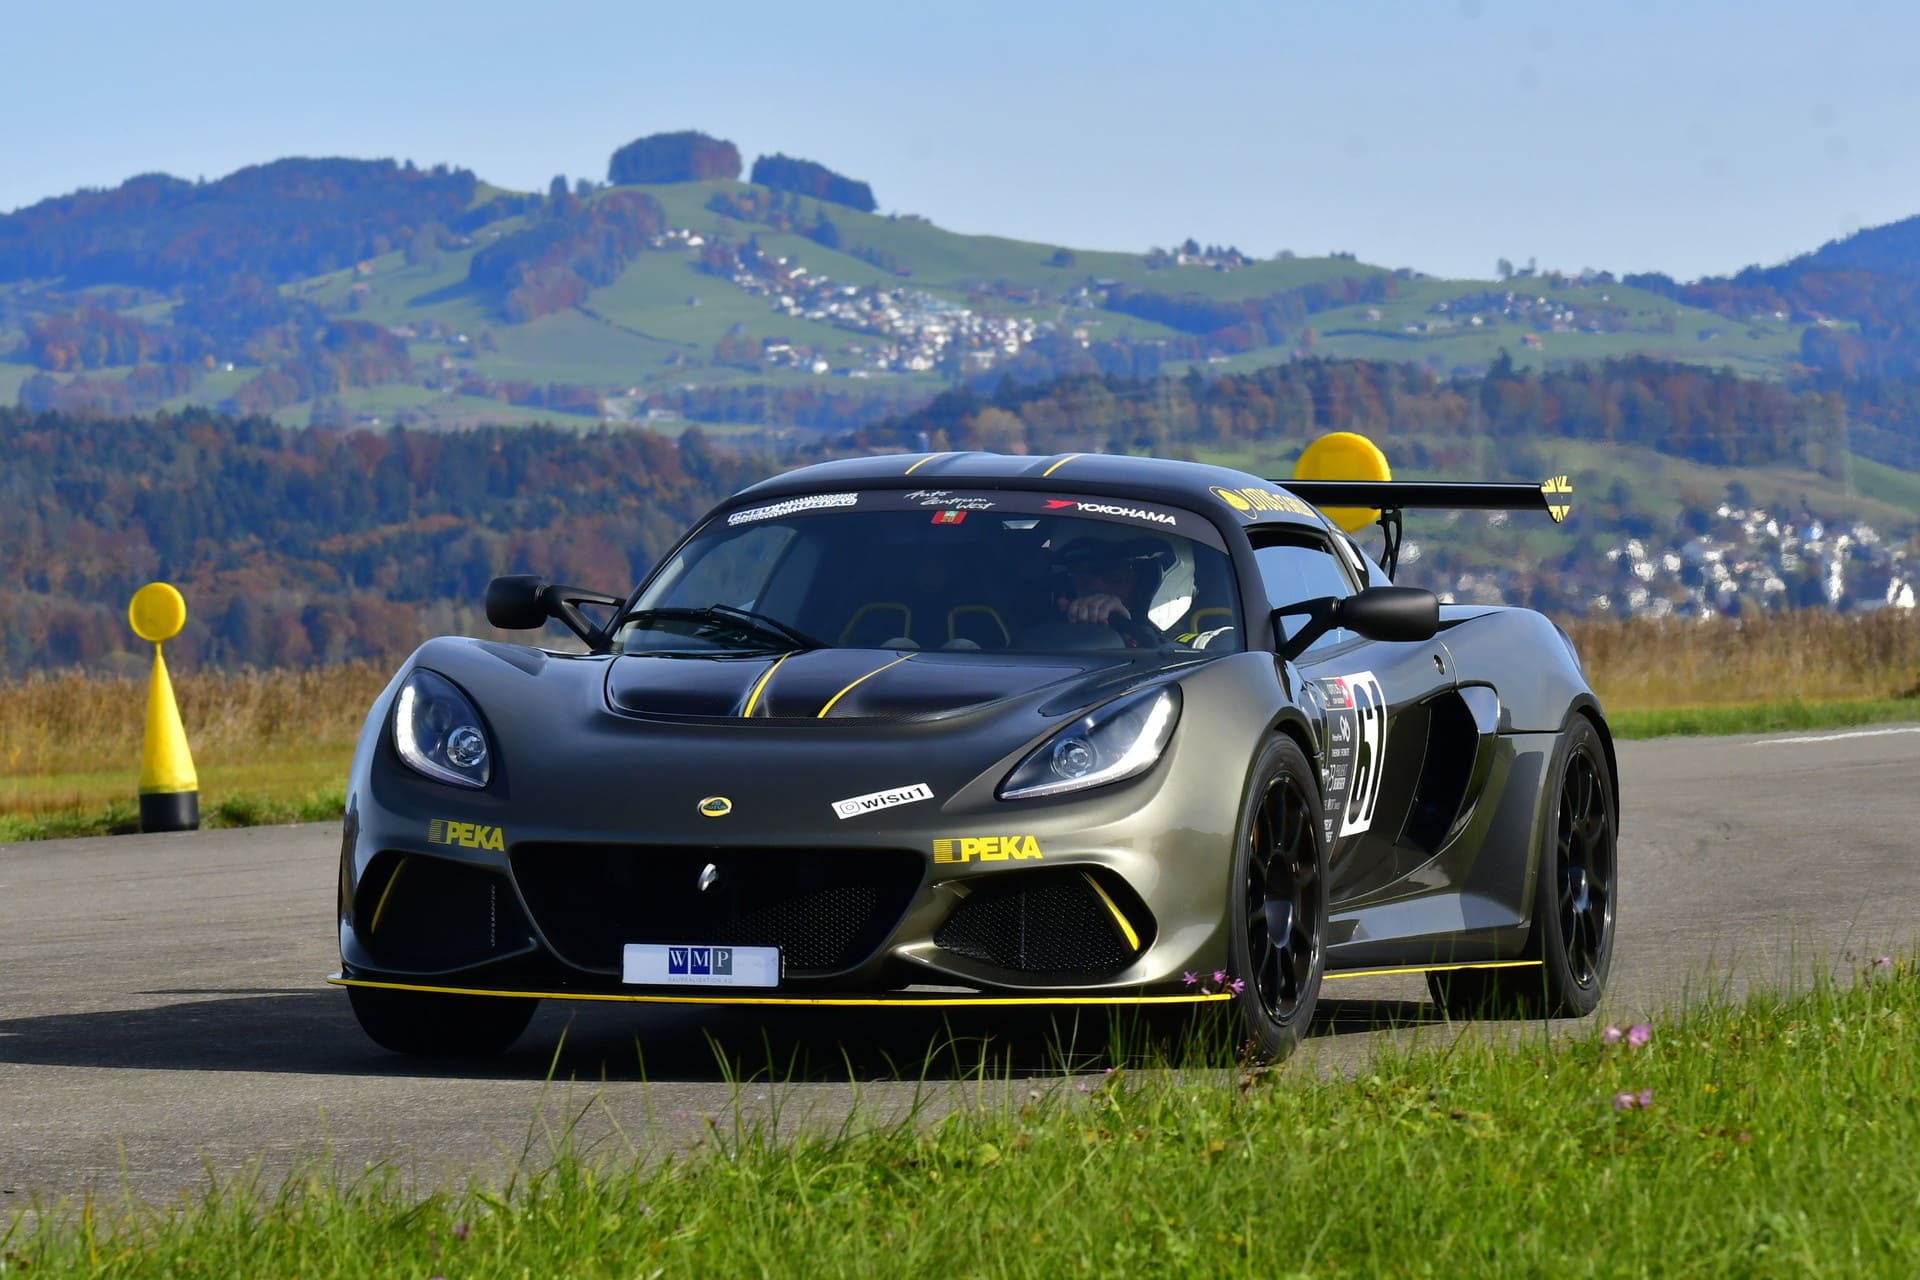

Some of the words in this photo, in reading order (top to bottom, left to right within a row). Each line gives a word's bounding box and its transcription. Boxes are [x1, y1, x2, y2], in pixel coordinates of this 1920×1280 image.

[904, 490, 953, 500] Auto
[1076, 502, 1177, 525] YOKOHAMA
[1348, 680, 1384, 826] 61
[861, 787, 927, 810] wisu1
[448, 822, 506, 852] PEKA
[960, 835, 1043, 862] PEKA
[669, 949, 731, 970] WMP
